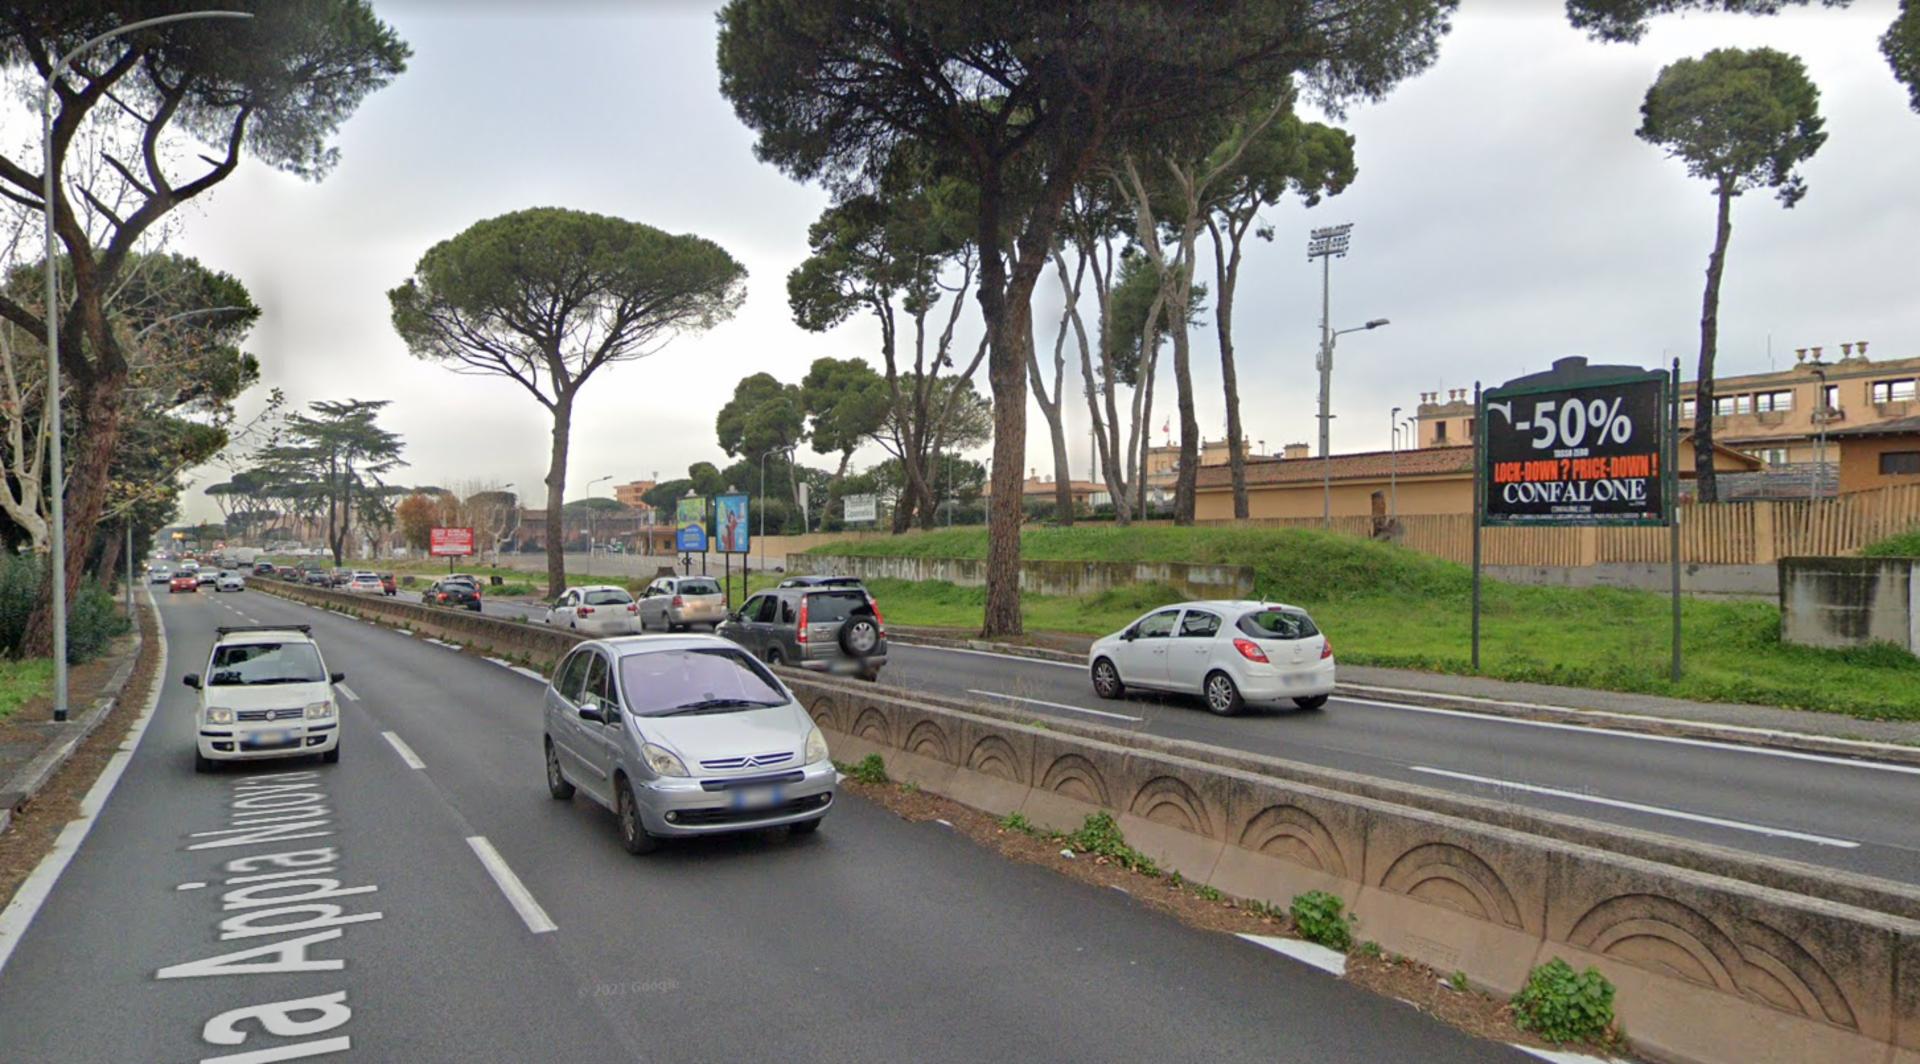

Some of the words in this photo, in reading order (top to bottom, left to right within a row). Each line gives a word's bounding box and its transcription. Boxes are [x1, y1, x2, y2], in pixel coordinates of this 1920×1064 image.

[1515, 397, 1632, 449] -50%
[1494, 459, 1559, 483] LOCK-DOWN
[1560, 459, 1570, 480] ?
[1572, 455, 1649, 480] PRICE-DOWN
[1503, 478, 1647, 504] CONFALONE
[185, 771, 336, 851] Nuova
[156, 847, 384, 979] Appia
[199, 990, 352, 1064] ia
